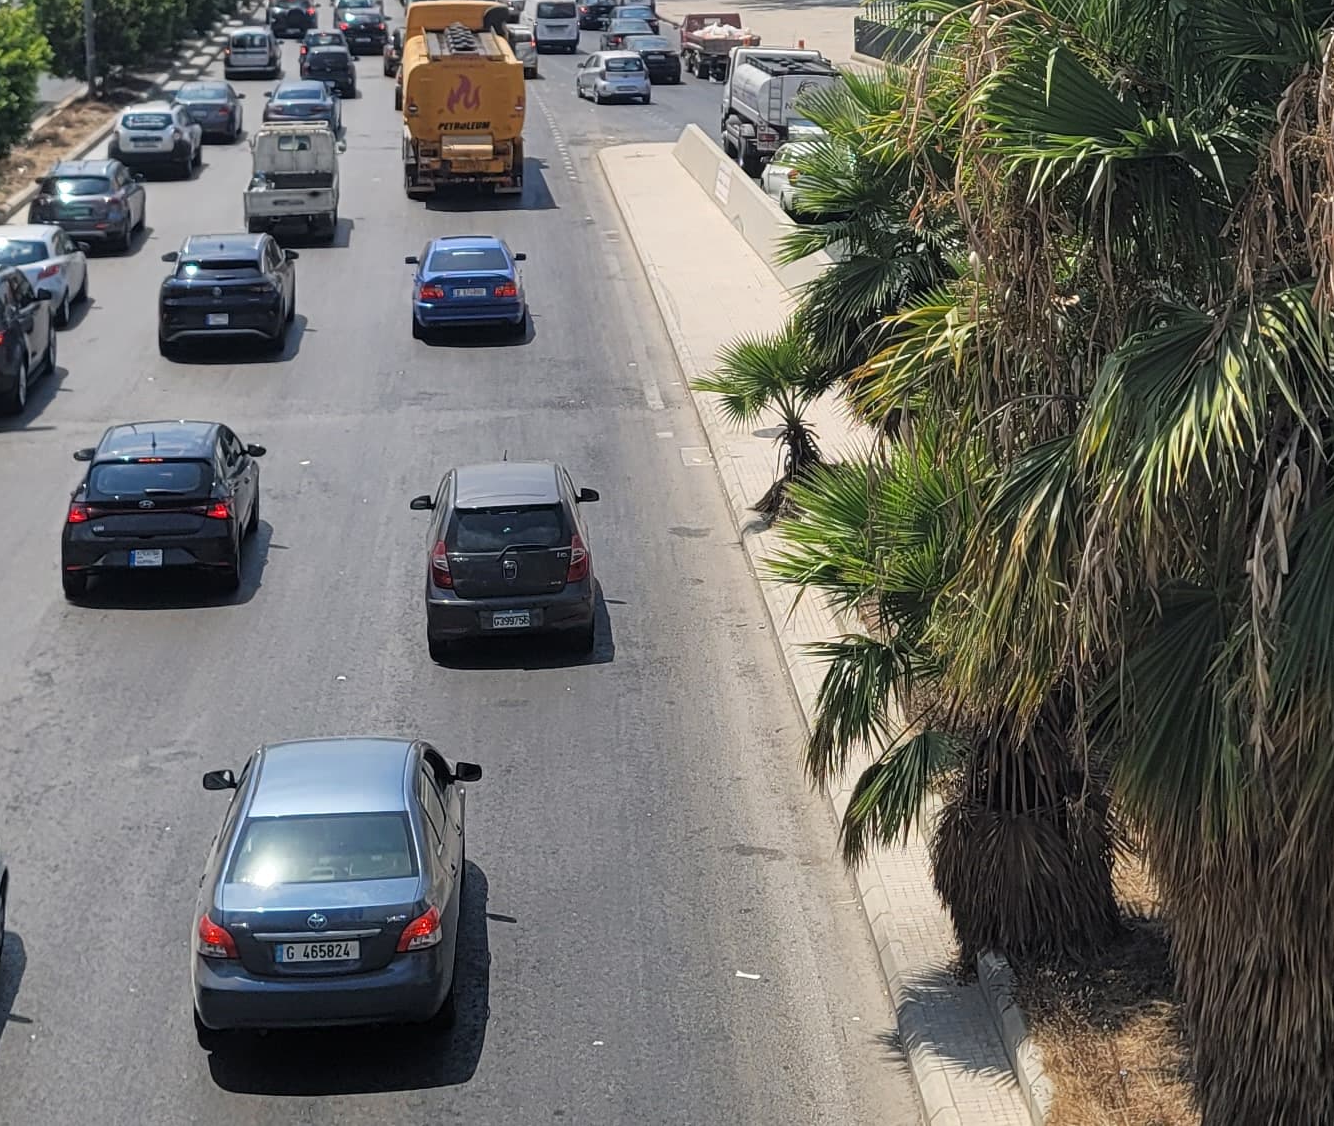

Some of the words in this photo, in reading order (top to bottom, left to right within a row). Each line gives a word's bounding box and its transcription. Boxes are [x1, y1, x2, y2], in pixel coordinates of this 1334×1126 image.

[438, 122, 491, 131] PETROLEUM
[287, 946, 295, 960] G
[303, 943, 350, 959] 465824
